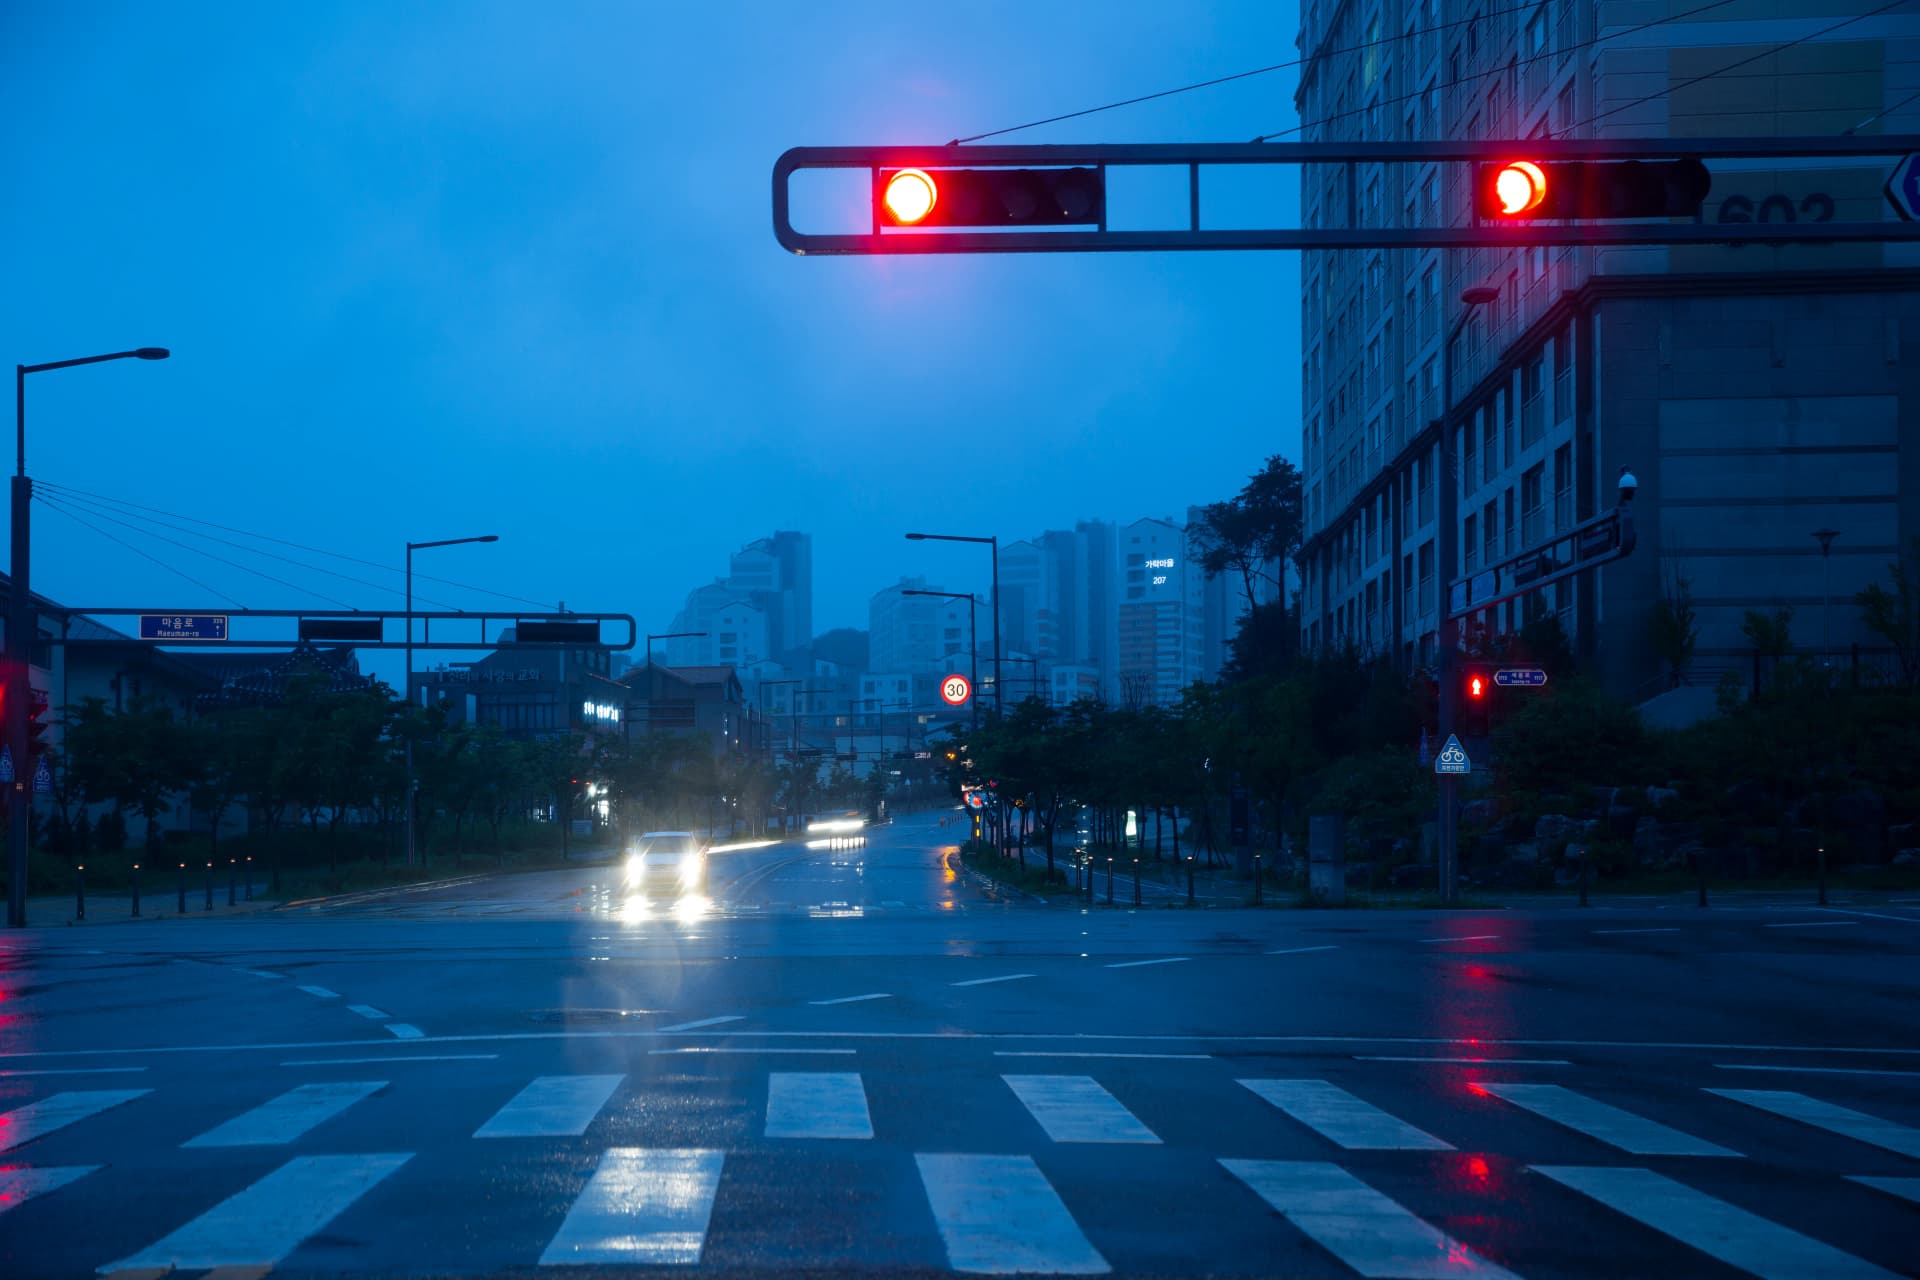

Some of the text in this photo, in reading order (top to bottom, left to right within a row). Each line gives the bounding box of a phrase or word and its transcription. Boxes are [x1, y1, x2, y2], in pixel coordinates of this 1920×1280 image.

[1145, 559, 1174, 568] 가락마을
[1153, 576, 1166, 585] 207
[161, 617, 195, 630] 마음로
[947, 683, 964, 697] 30
